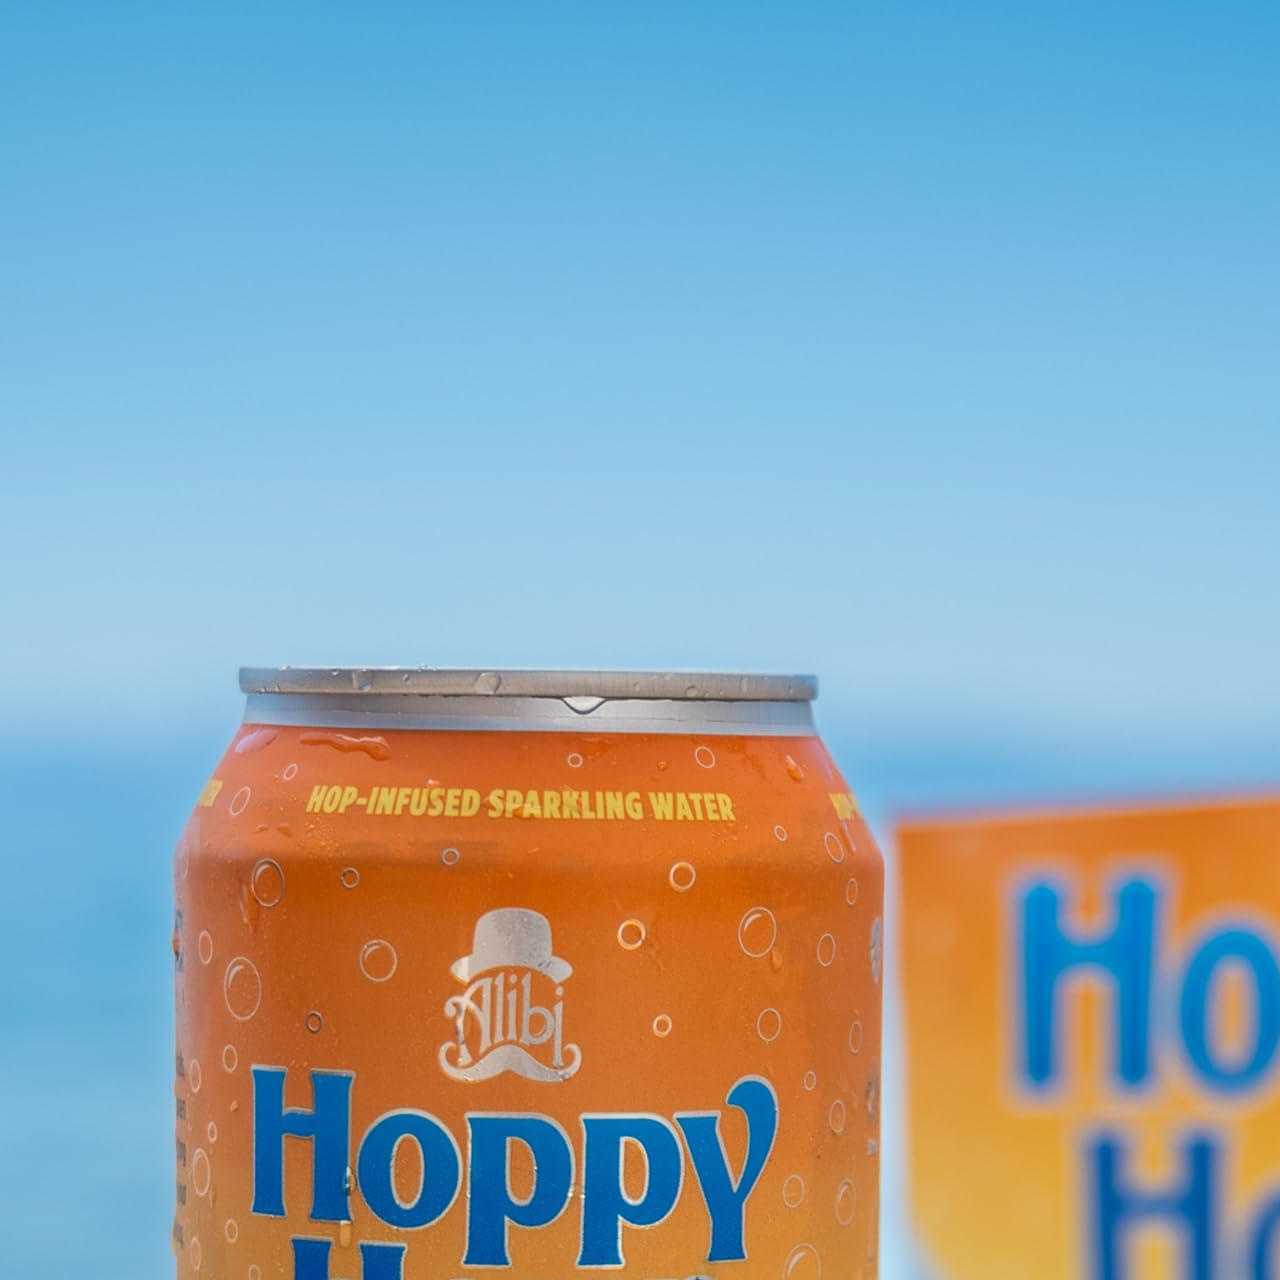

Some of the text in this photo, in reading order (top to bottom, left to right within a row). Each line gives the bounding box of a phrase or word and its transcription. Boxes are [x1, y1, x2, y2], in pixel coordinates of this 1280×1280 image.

[304, 784, 737, 822] HOP-INFUSED SPARKLING WATER
[444, 971, 564, 1067] Alibi
[250, 1064, 780, 1267] Hoppy
